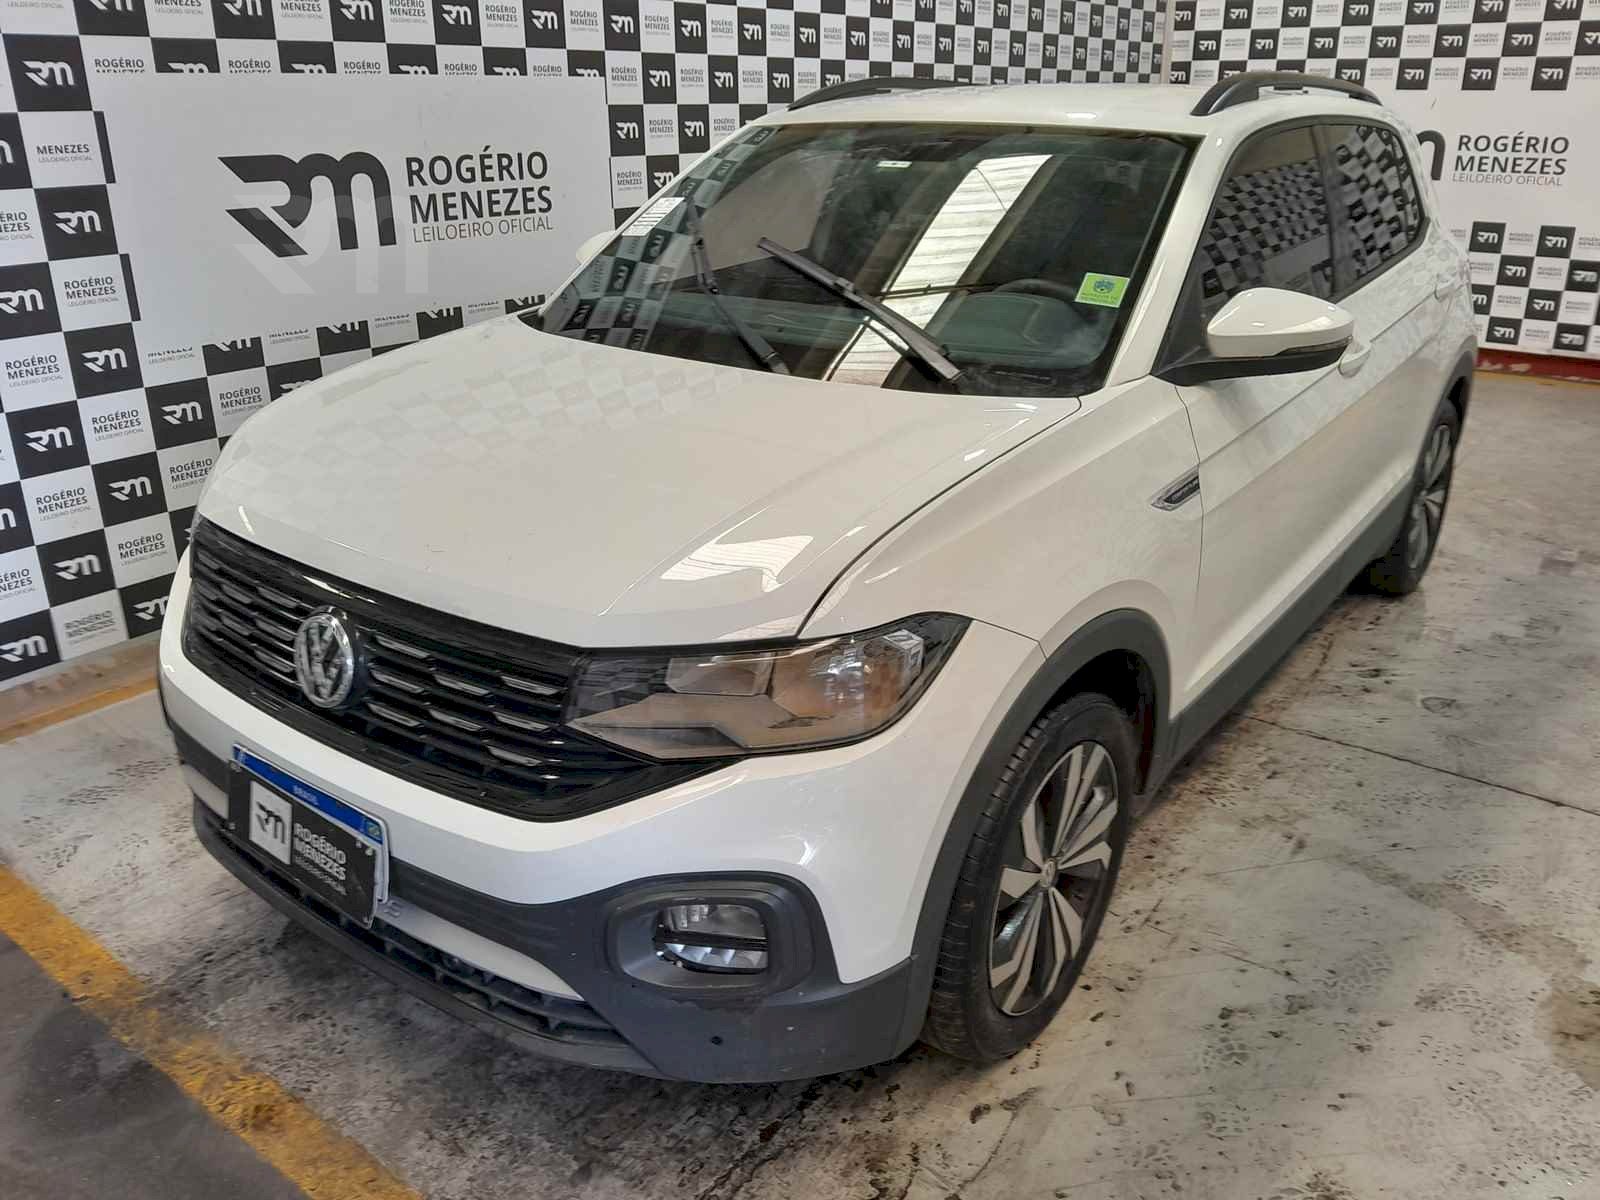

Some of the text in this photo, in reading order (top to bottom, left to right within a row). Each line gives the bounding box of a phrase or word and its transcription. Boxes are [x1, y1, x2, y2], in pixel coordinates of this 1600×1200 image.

[280, 3, 322, 12] MENEZES
[389, 7, 426, 17] MENEZES
[486, 13, 518, 22] MENEZES
[94, 57, 145, 69] ROGÉRIO
[228, 59, 271, 69] ROGÉRIO
[343, 60, 381, 70] ROGÉRIO
[36, 144, 90, 155] MENEZES
[1457, 131, 1570, 154] ROGÉRIO
[405, 145, 549, 188] ROGÉRIO
[1454, 155, 1568, 175] MENEZES
[409, 185, 553, 224] MENEZES
[412, 214, 554, 243] LEILOEIRO OFICIAL
[64, 276, 113, 290] ROGÉRIO
[66, 286, 116, 300] MENEZES
[5, 354, 57, 370] ROGÉRIO
[7, 363, 61, 380] MENEZES
[219, 386, 261, 401] ROGÉRIO
[220, 395, 263, 409] MENEZES
[91, 409, 139, 425] ROGÉRIO
[94, 418, 142, 435] MENEZES
[169, 458, 213, 475] ROGÉRIO
[35, 487, 85, 505] ROGÉRIO
[38, 496, 88, 514] MENEZES
[118, 533, 163, 551] ROGÉRIO
[120, 541, 166, 560] MENEZES
